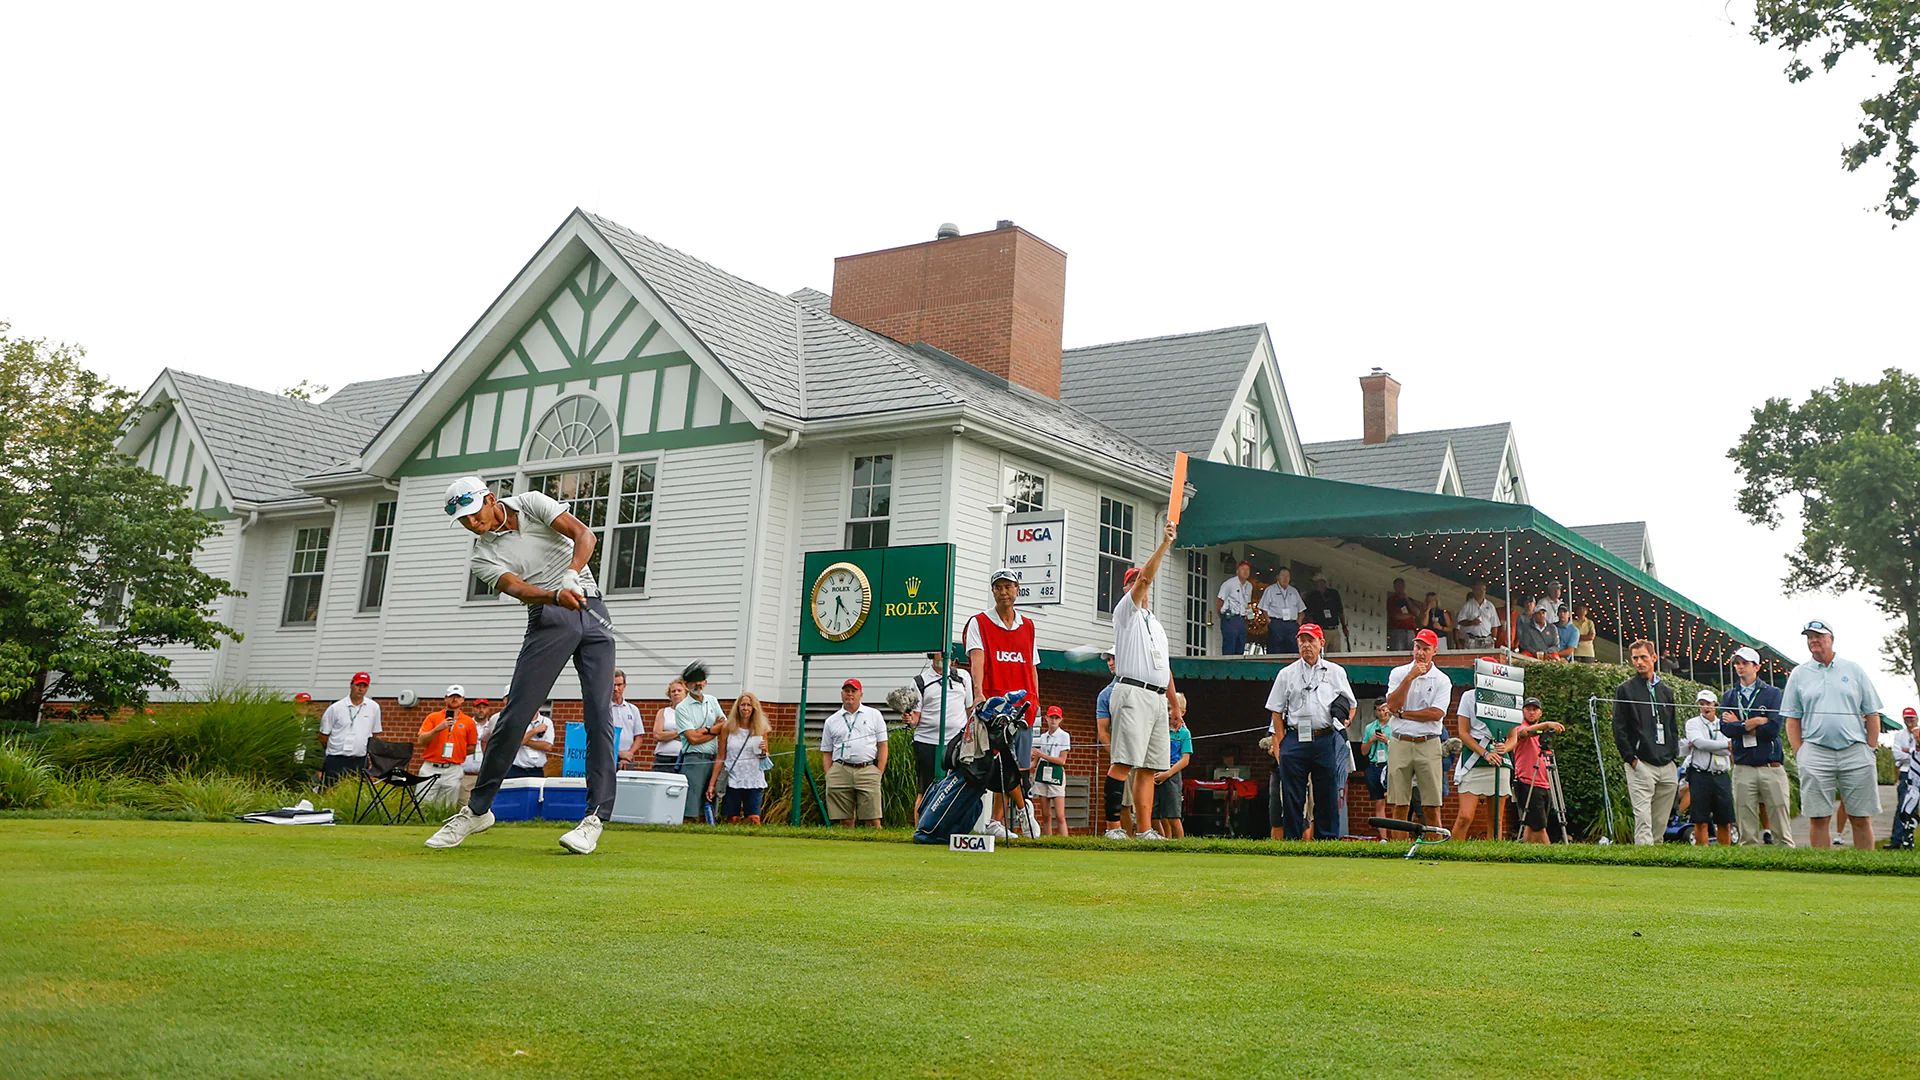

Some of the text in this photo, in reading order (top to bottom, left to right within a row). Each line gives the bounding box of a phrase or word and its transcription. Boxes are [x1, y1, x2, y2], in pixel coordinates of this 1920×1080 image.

[1017, 528, 1052, 542] USGA
[1009, 553, 1052, 564] HOLE 1
[1046, 569, 1051, 578] 4
[1017, 586, 1054, 597] RDS 482
[885, 601, 939, 617] ROLEX
[996, 650, 1024, 663] USGA
[1492, 664, 1509, 677] USGA
[1484, 706, 1507, 719] CASTILLO
[954, 836, 986, 850] USGA
